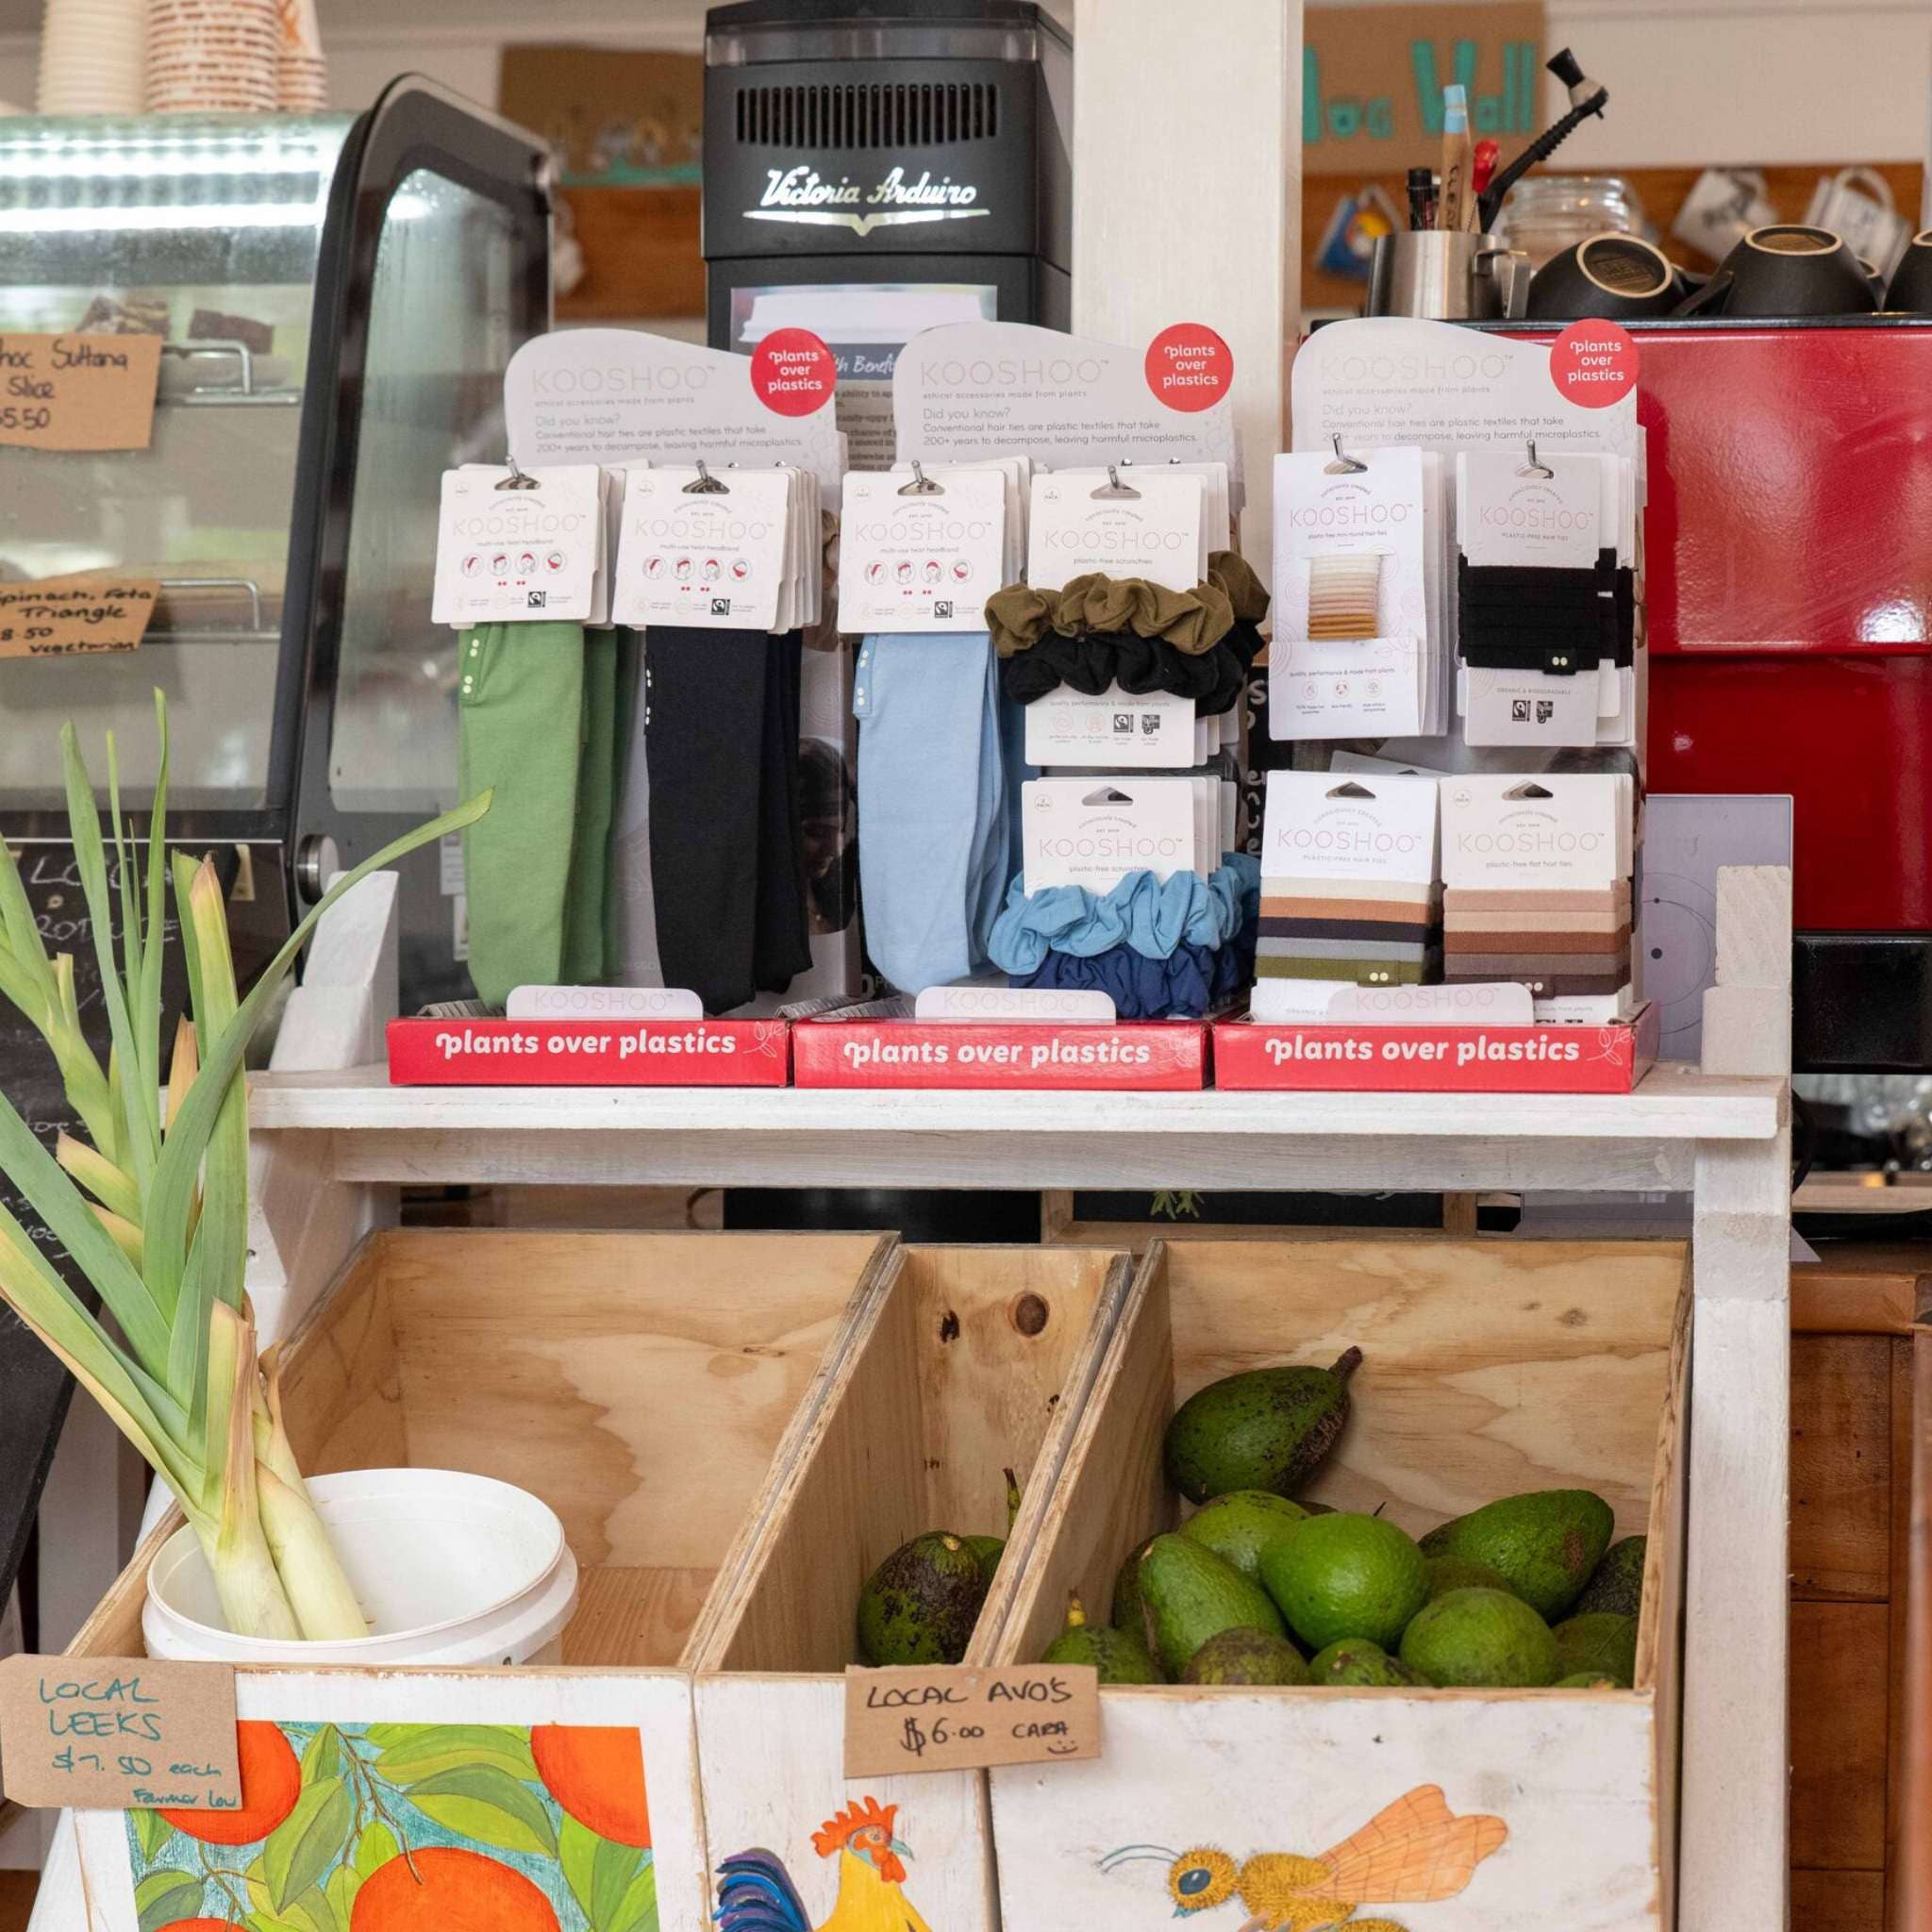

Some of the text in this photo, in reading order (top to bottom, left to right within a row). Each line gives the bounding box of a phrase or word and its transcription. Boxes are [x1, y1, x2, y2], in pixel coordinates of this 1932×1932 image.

[760, 166, 977, 207] Victoria Arduino
[1164, 345, 1216, 358] plants
[1570, 341, 1623, 354] plants
[51, 339, 128, 372] Sultana
[769, 351, 820, 364] plants
[1580, 356, 1613, 367] over
[780, 365, 810, 376] over
[1175, 359, 1207, 371] over
[1163, 374, 1219, 389] plastics
[1568, 369, 1625, 385] plastics
[8, 375, 56, 399] Slice
[768, 379, 823, 394] plastics
[924, 423, 985, 432] Conventional
[987, 423, 1007, 431] hair
[1010, 423, 1027, 431] ties
[1046, 422, 1079, 432] plastic
[1081, 421, 1114, 430] textiles
[1117, 421, 1137, 430] that
[1140, 421, 1160, 430] take
[1322, 419, 1385, 429] Conventional
[1388, 419, 1407, 428] hair
[1409, 418, 1426, 427] ties
[1447, 416, 1480, 427] plastic
[1483, 416, 1517, 425] textiles
[1520, 416, 1540, 425] that
[1542, 415, 1564, 425] take
[536, 429, 595, 440] Conventional
[597, 427, 615, 438] hair
[619, 427, 636, 437] ties
[656, 427, 687, 439] plastic
[690, 426, 722, 436] textiles
[724, 425, 743, 435] that
[746, 425, 766, 435] take
[1353, 434, 1381, 444] years
[1383, 433, 1392, 442] to
[1393, 430, 1454, 443] decompose,
[1456, 430, 1491, 441] leaving
[1493, 430, 1533, 441] harmful
[537, 443, 562, 453] 200+
[565, 444, 591, 455] years
[592, 442, 604, 452] to
[607, 441, 661, 453] decompose,
[664, 440, 696, 451] leaving
[700, 439, 737, 448] harmful
[924, 437, 950, 446] 200+
[953, 438, 979, 448] years
[981, 436, 991, 446] to
[993, 435, 1053, 447] decompose,
[1055, 435, 1089, 446] leaving
[1091, 434, 1129, 443] harmful
[19, 605, 127, 625] Triangle
[436, 1028, 735, 1059] plants over plastics
[1265, 1034, 1579, 1066] plants over plastics
[843, 1038, 1150, 1069] plants over plastics
[40, 1677, 160, 1704] LOCAL
[867, 1677, 1073, 1708] LOCAL AVO'S
[50, 1708, 161, 1741] LEEKS
[169, 1763, 222, 1777] each
